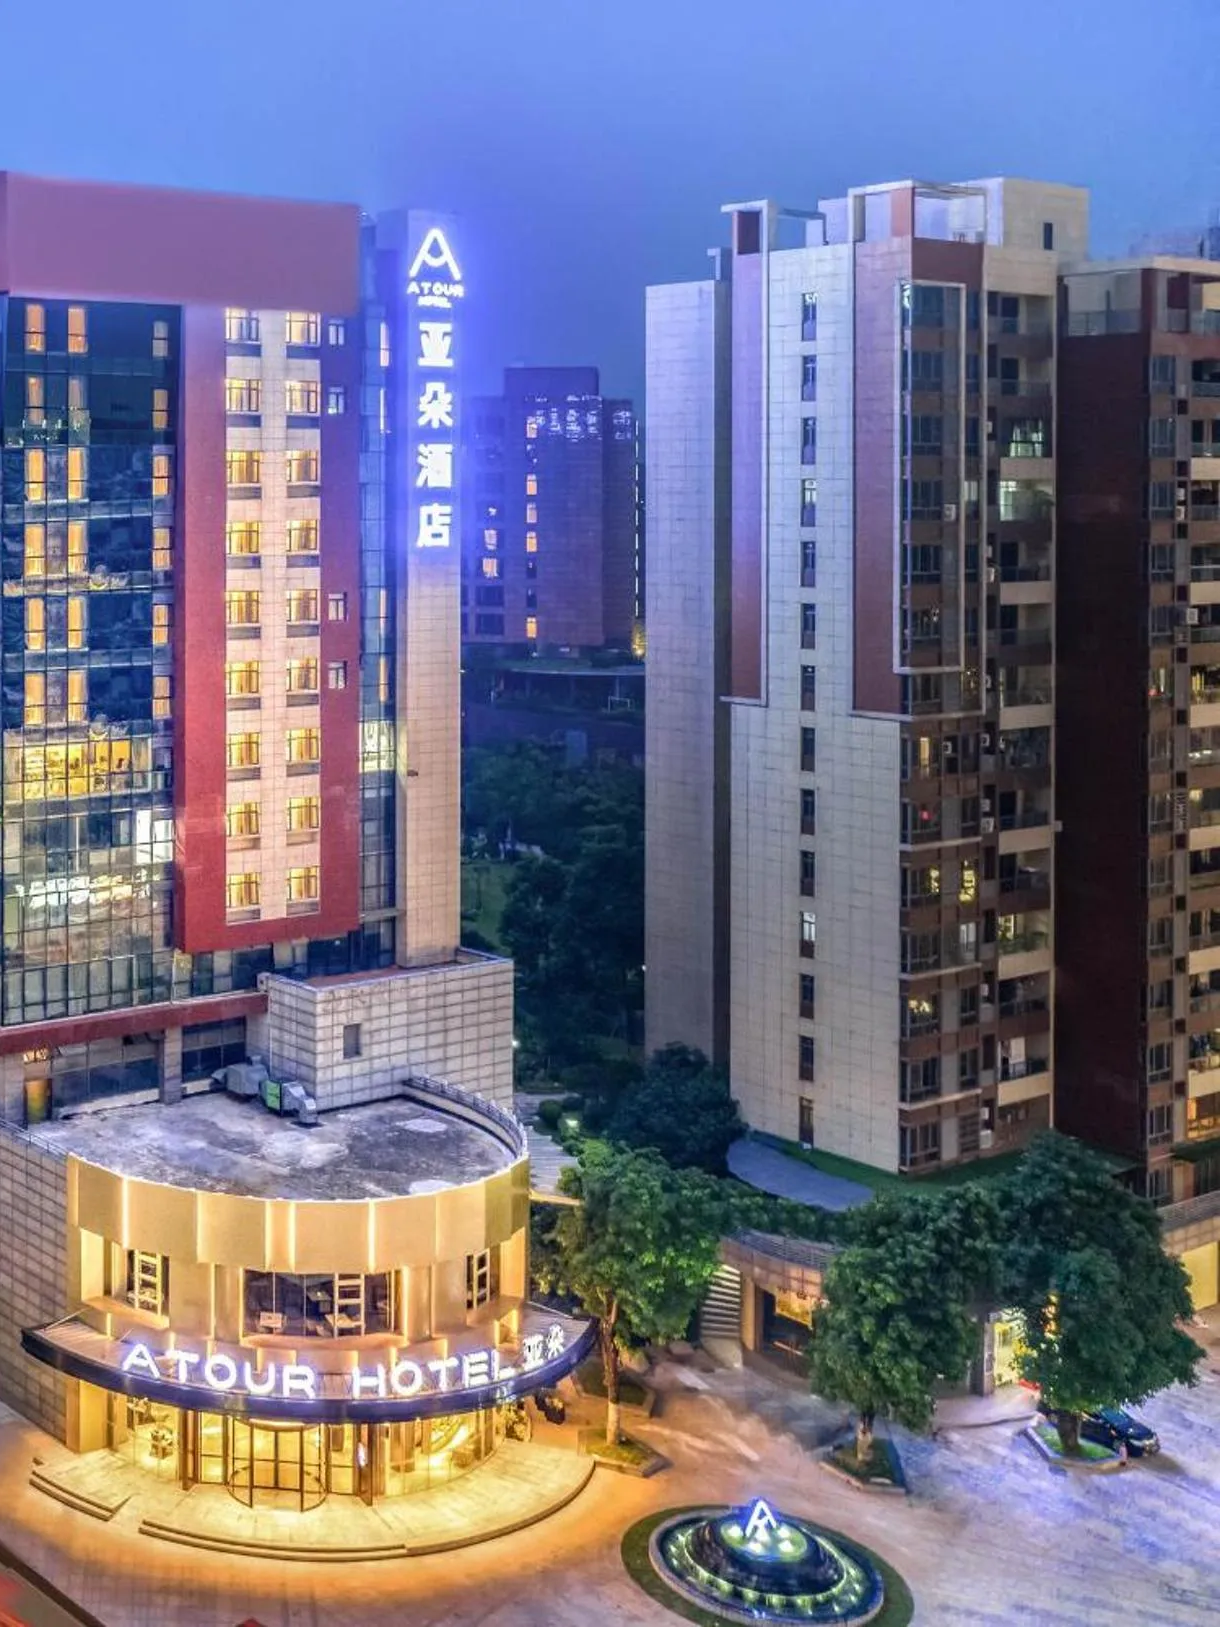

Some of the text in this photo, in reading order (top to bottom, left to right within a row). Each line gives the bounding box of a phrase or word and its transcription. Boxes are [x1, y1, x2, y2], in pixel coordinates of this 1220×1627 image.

[407, 281, 465, 298] ATOUR
[416, 322, 454, 548] 亚朵酒店
[122, 1343, 516, 1399] ATOUR HOTEL
